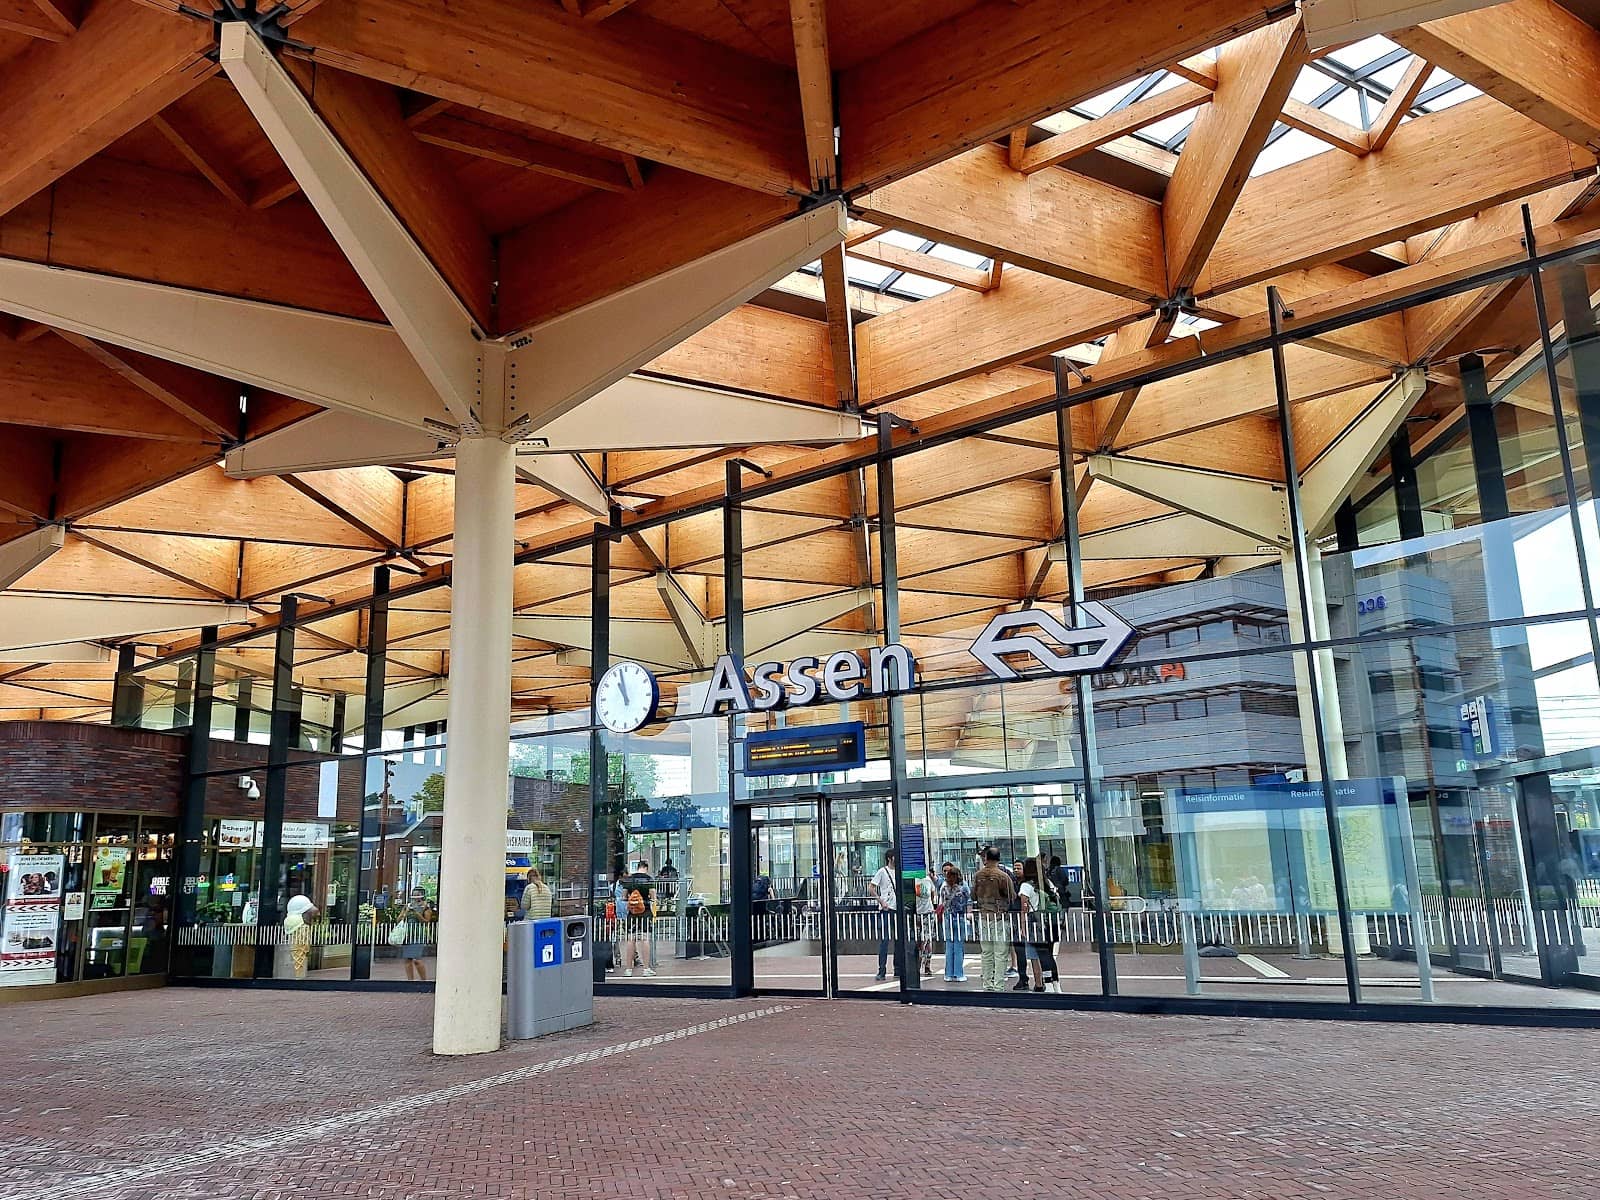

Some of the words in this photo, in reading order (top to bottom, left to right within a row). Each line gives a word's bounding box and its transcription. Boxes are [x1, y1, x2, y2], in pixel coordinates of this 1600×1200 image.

[702, 643, 914, 715] Assen
[1185, 792, 1246, 804] Reisinformatie
[1290, 787, 1356, 799] Reisinfoatie
